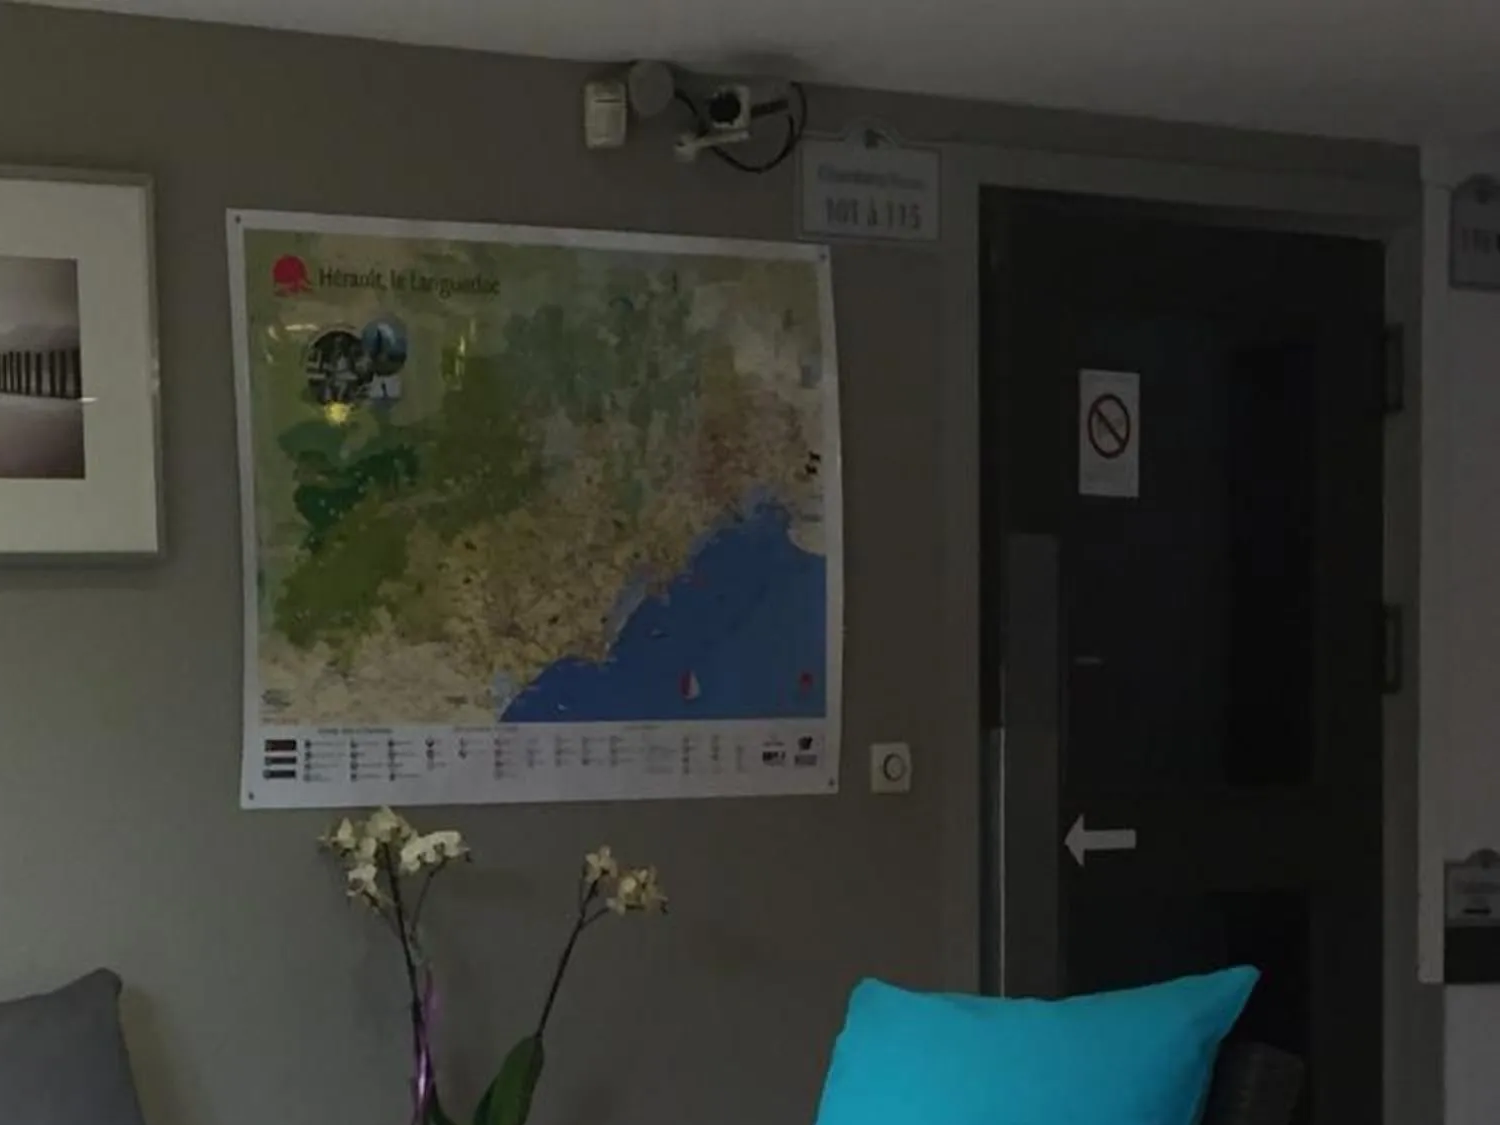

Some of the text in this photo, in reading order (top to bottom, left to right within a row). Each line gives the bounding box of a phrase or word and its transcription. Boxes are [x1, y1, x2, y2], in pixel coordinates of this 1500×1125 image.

[826, 196, 858, 225] 101
[886, 200, 922, 230] 115
[410, 269, 500, 298] Languedoc
